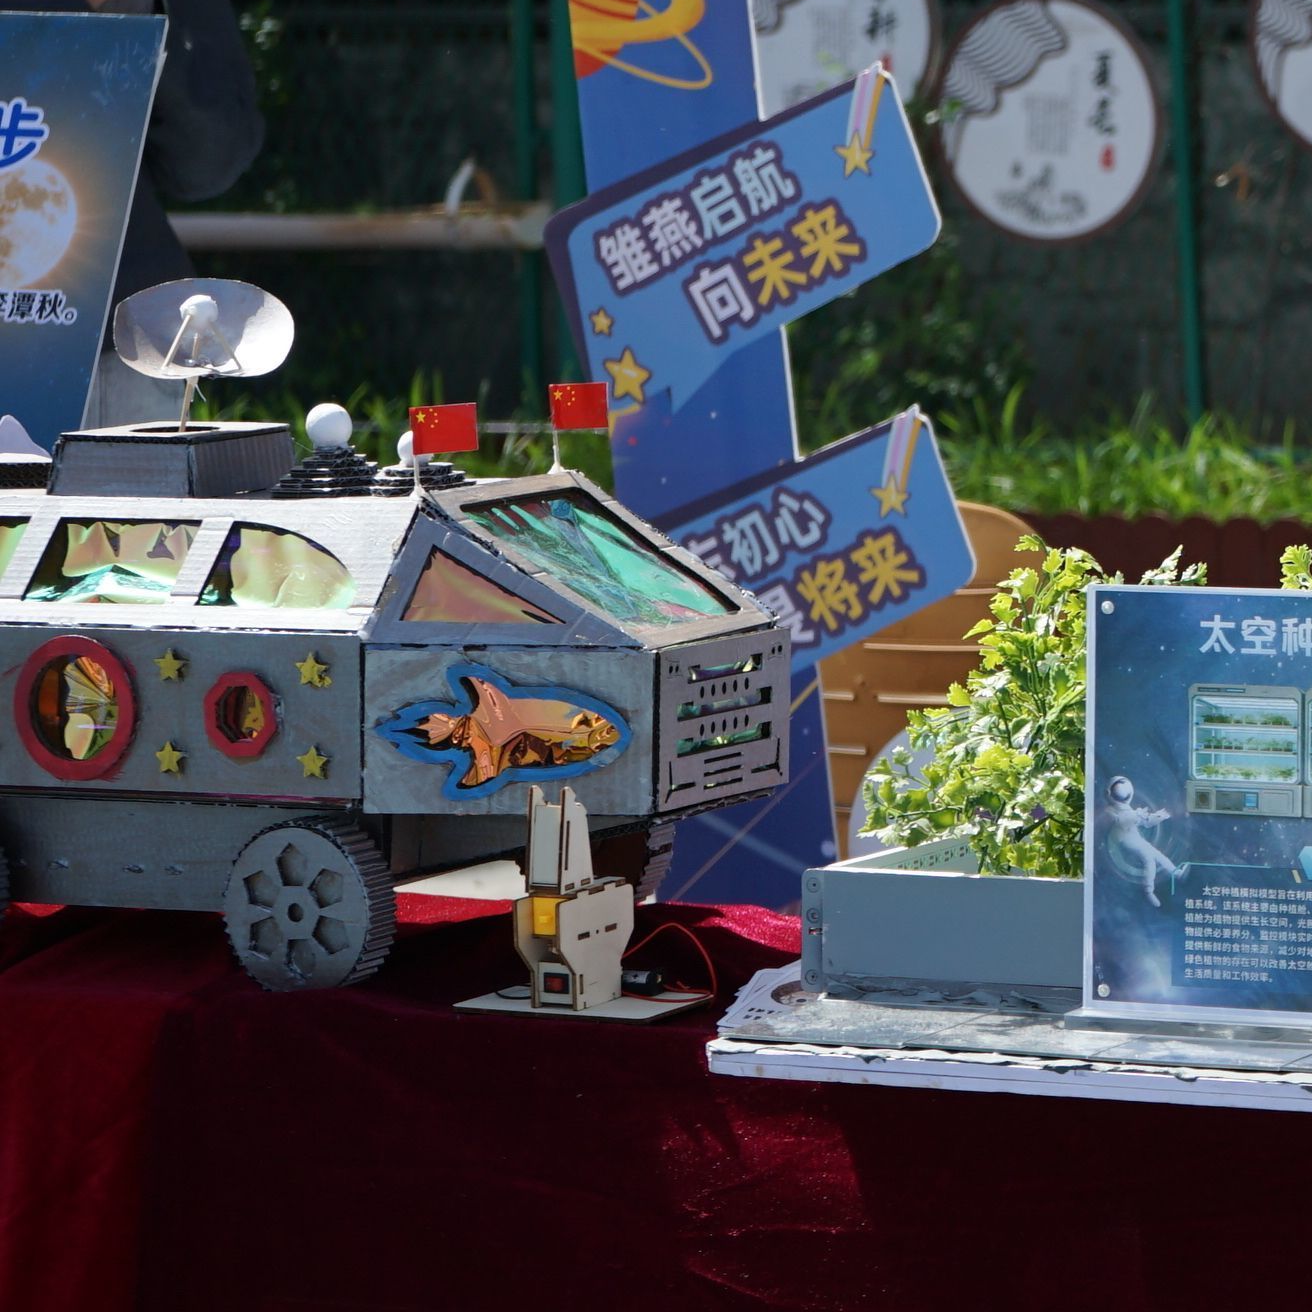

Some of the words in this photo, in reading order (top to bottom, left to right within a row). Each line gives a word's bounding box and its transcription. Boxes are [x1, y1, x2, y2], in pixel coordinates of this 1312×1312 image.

[598, 147, 796, 291] 雏燕启航
[688, 205, 861, 339] 向未来
[0, 292, 76, 325] 潭秋。
